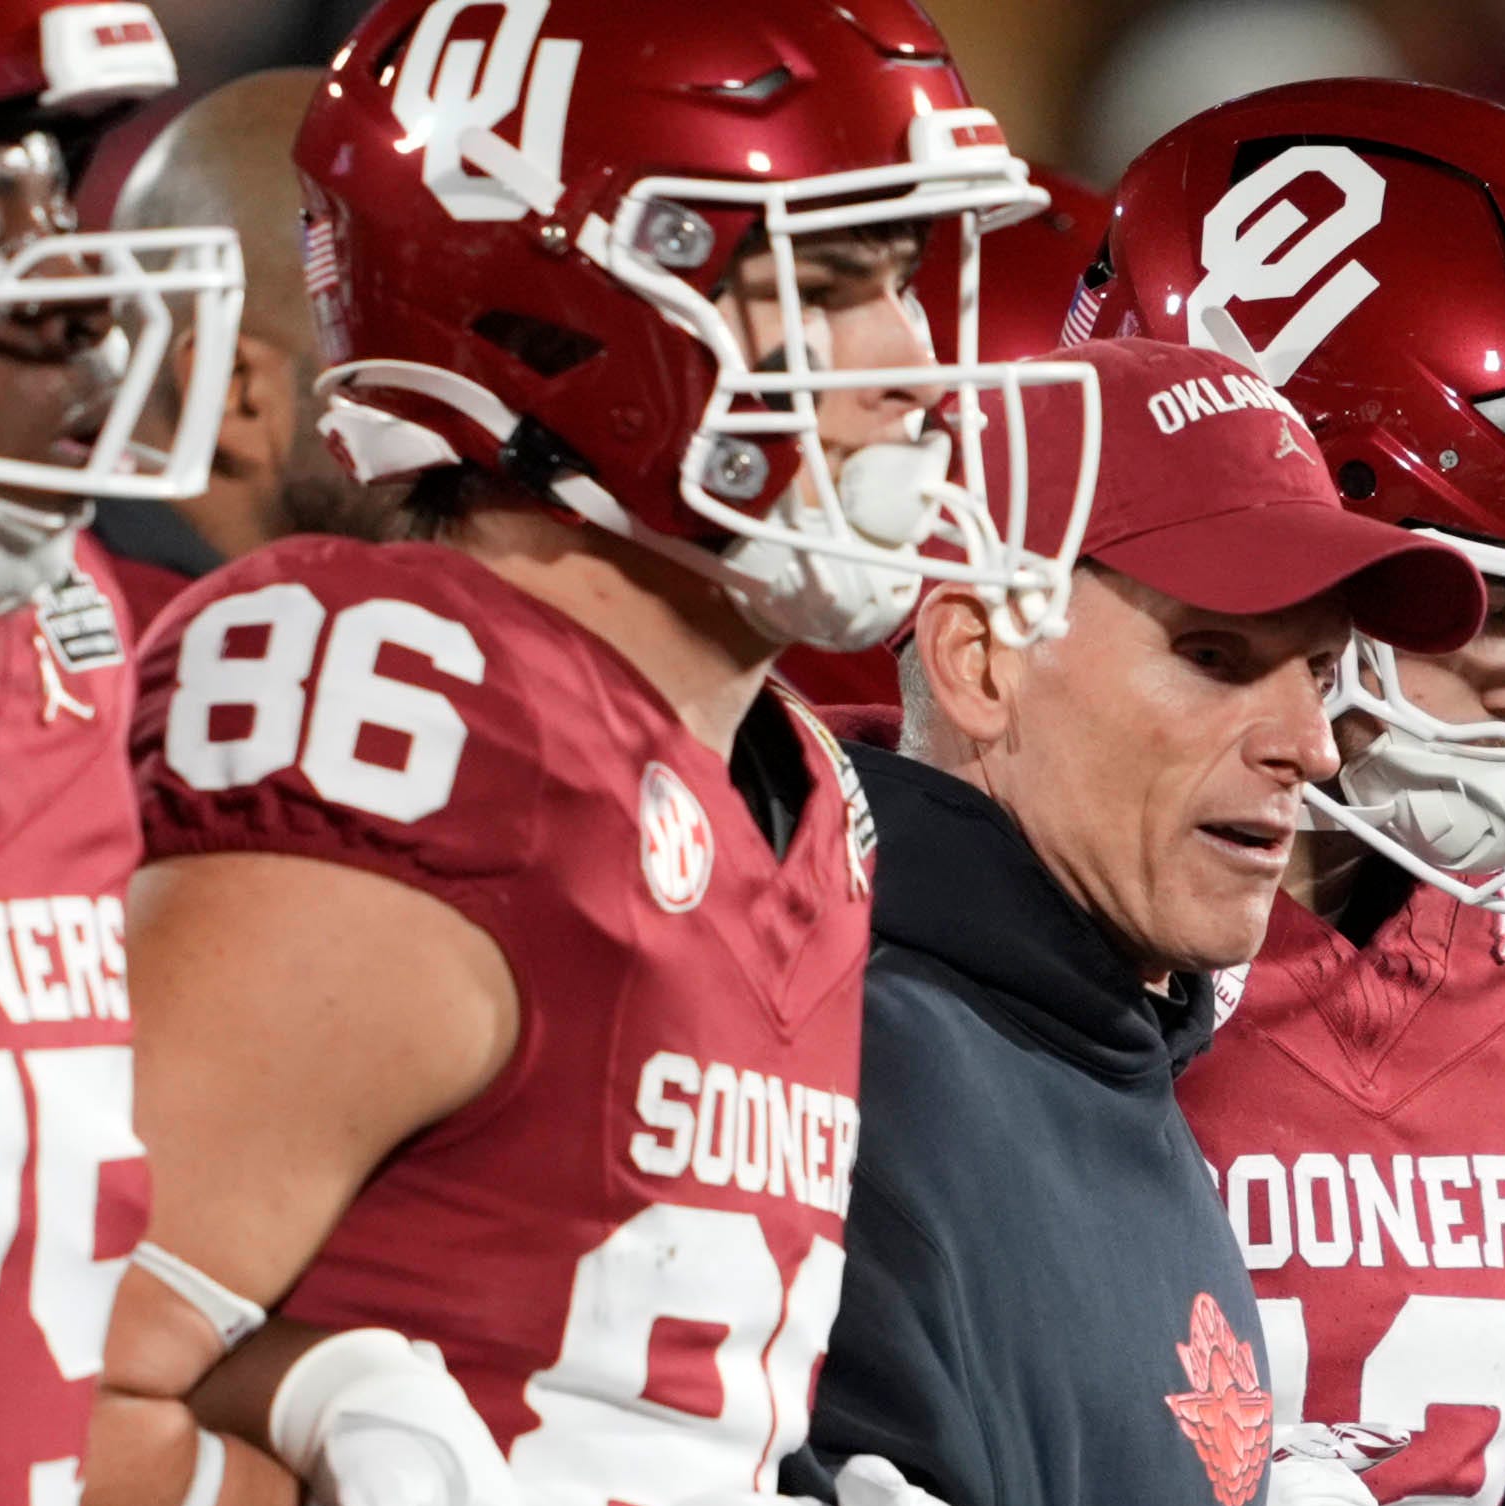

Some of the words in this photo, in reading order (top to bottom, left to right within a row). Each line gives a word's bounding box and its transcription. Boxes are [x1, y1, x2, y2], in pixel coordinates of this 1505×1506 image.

[392, 0, 582, 221] OU
[1187, 145, 1387, 387] OU
[1147, 374, 1316, 441] OKLAH
[166, 583, 485, 824] 86
[628, 1050, 861, 1221] SOONER
